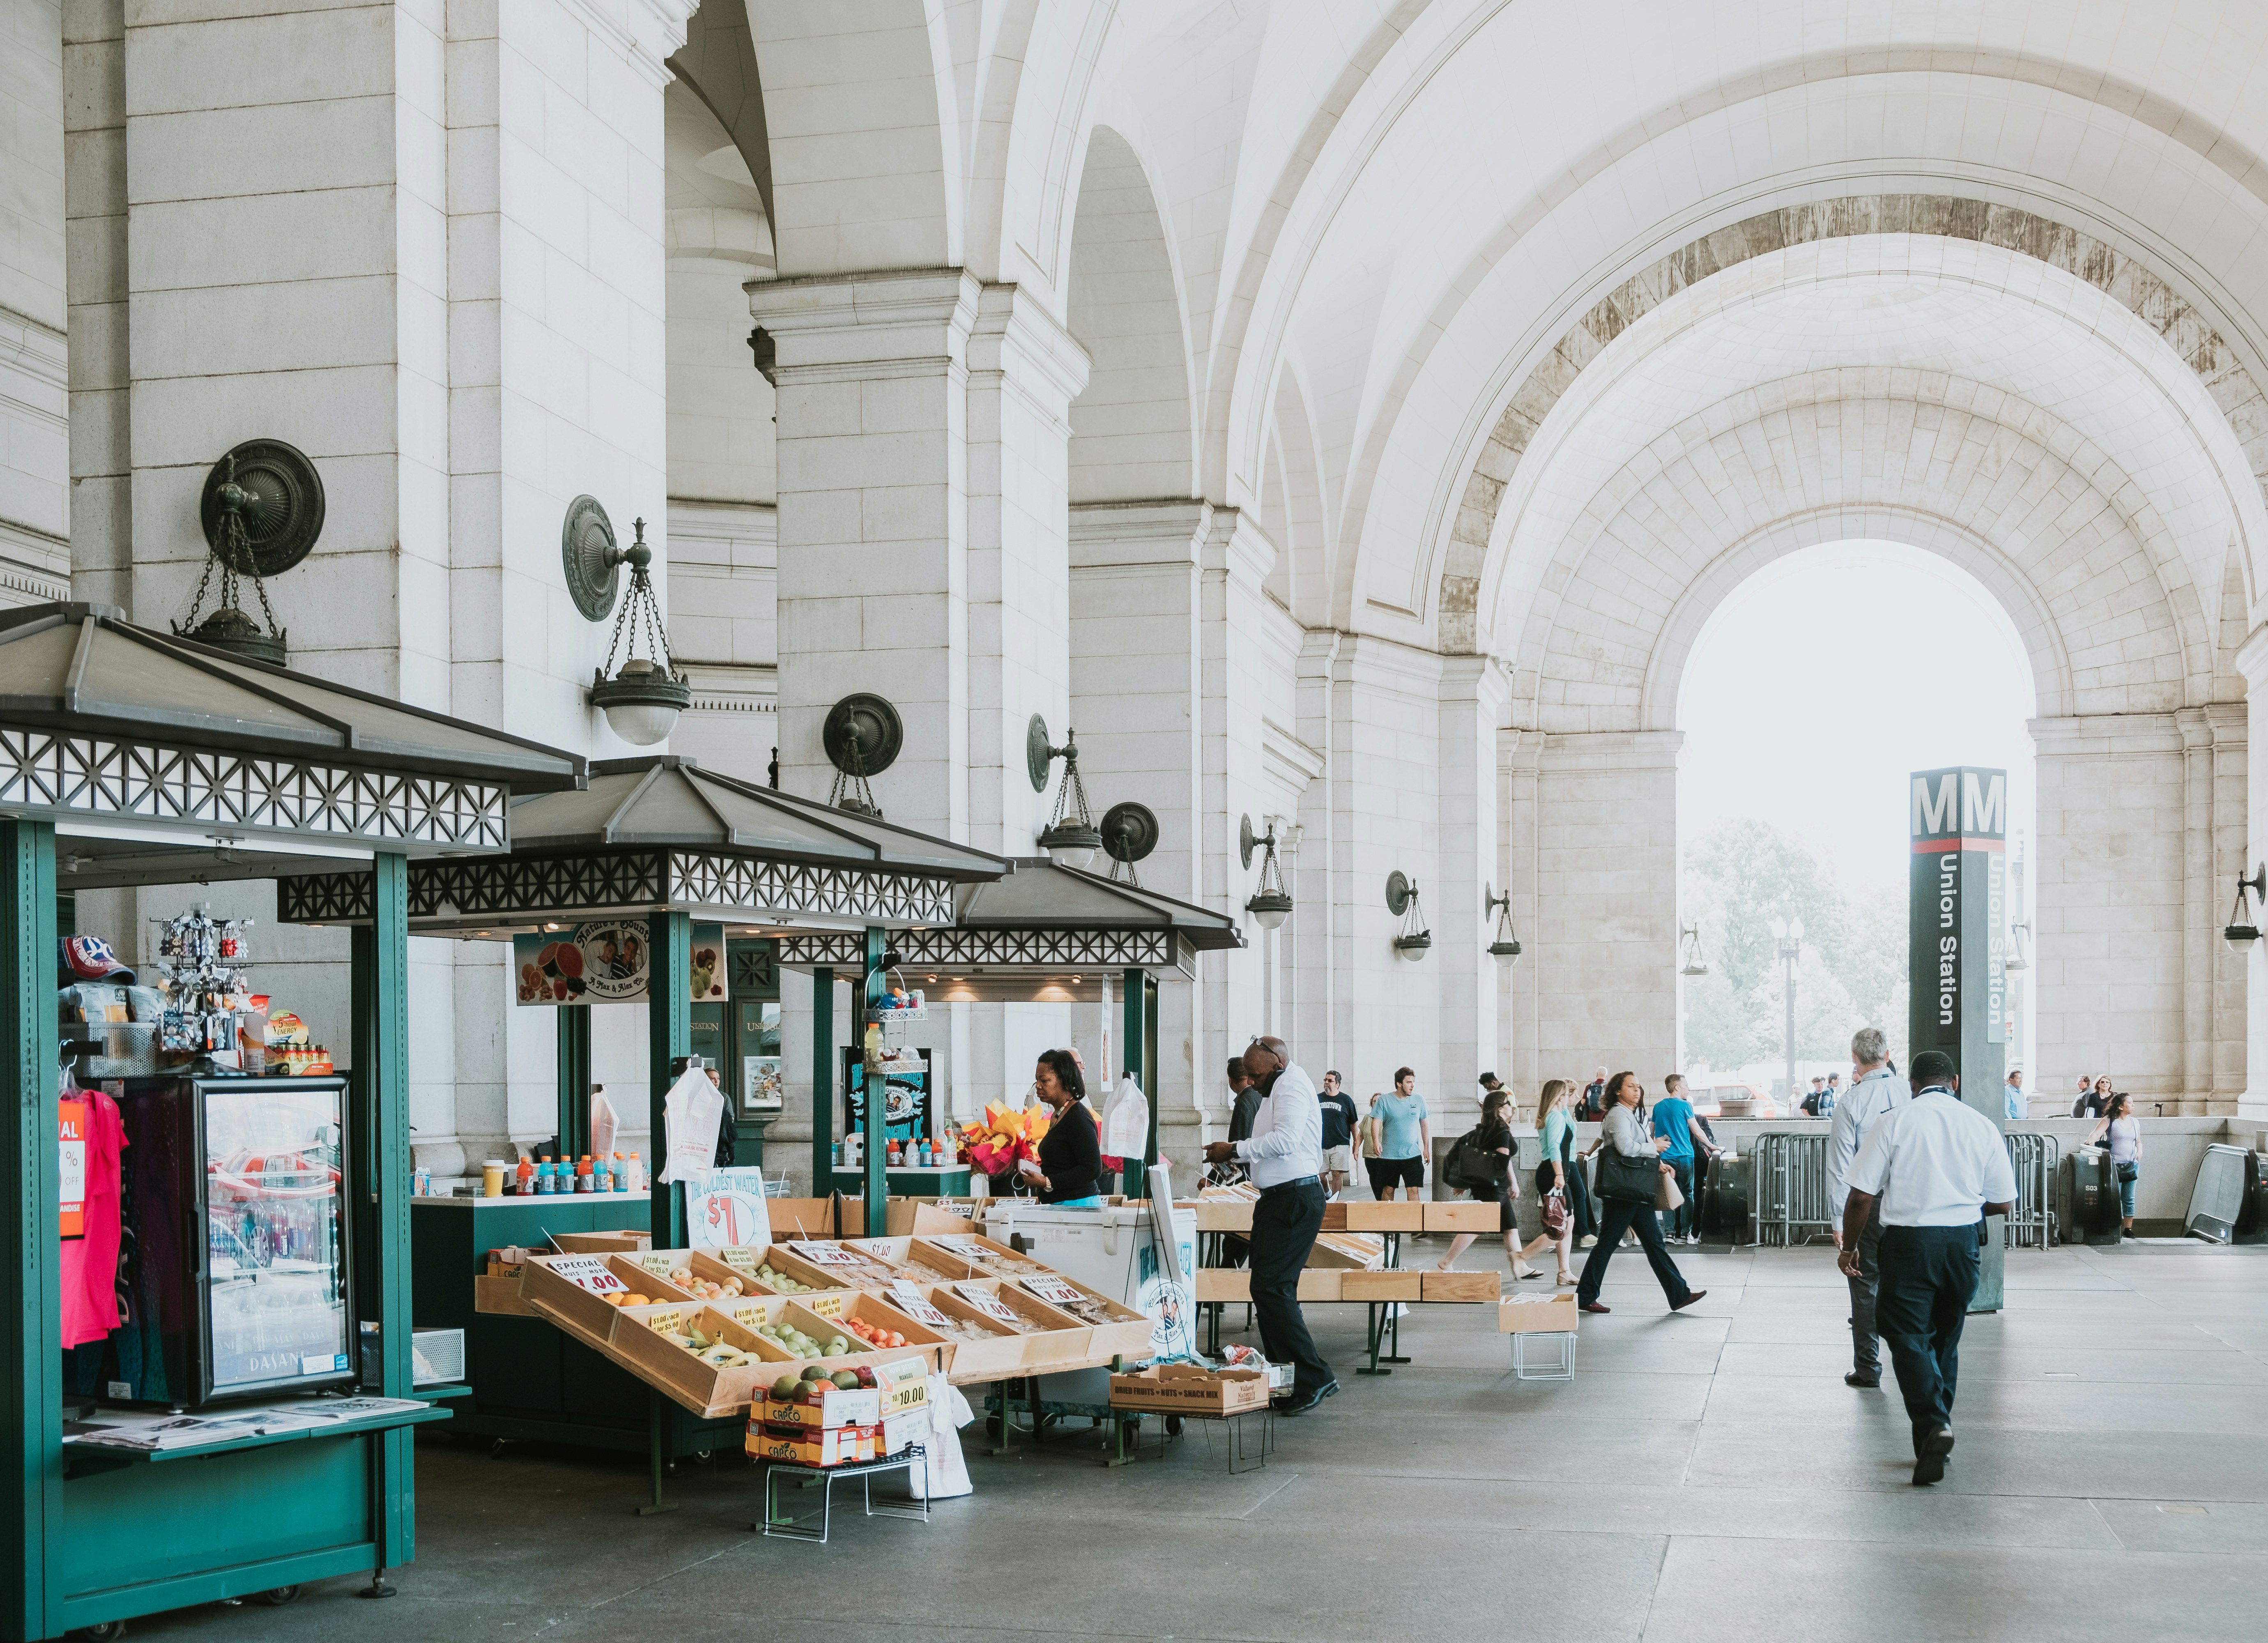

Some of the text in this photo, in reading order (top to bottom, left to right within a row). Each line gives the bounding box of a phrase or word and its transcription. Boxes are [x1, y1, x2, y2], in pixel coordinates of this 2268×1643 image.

[1912, 774, 1957, 835] M
[1964, 773, 2004, 834] M
[1940, 854, 1957, 1025] Union Station
[1989, 855, 2004, 1024] Union Station
[596, 980, 610, 990] Max
[612, 985, 617, 993] &
[618, 983, 633, 993] Alex
[1320, 1102, 1342, 1111] ORGETOWN
[914, 1116, 924, 1141] DC
[65, 1176, 79, 1185] OFF
[734, 1175, 761, 1199] WATER
[707, 1193, 739, 1245] $1
[557, 1260, 601, 1270] SPECIAL
[960, 1287, 993, 1297] SPECIAL
[653, 1315, 666, 1325] $1.00
[738, 1309, 752, 1318] $1.00
[1168, 1329, 1178, 1340] Alex
[250, 1351, 304, 1372] DASANI
[902, 1362, 917, 1372] price
[1133, 1387, 1155, 1396] FRUITS
[1184, 1390, 1205, 1398] SNACK
[1206, 1390, 1219, 1399] MIX
[773, 1409, 801, 1422] CAPCO
[768, 1446, 798, 1460] CAPCO
